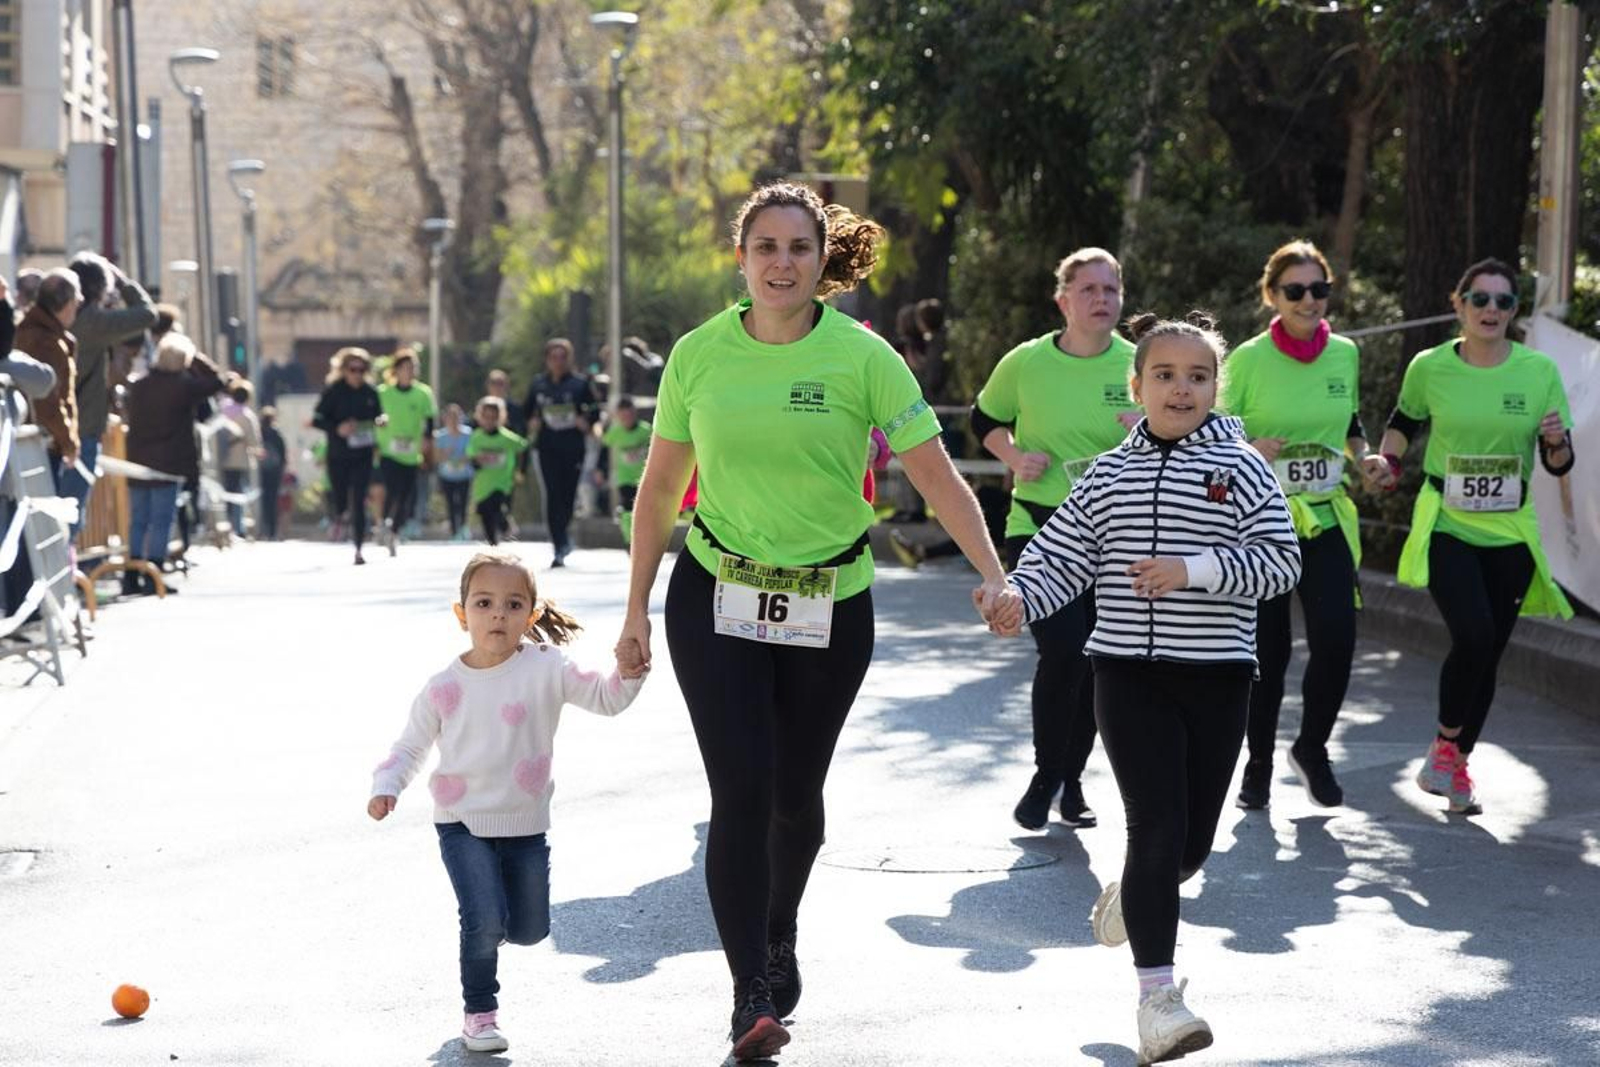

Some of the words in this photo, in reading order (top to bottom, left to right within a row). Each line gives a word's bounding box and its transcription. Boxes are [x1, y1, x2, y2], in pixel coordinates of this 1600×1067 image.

[1288, 459, 1328, 482] 630
[1463, 476, 1504, 498] 582
[735, 571, 764, 588] CARRERA
[764, 578, 793, 590] POPULAR
[757, 592, 789, 623] 16
